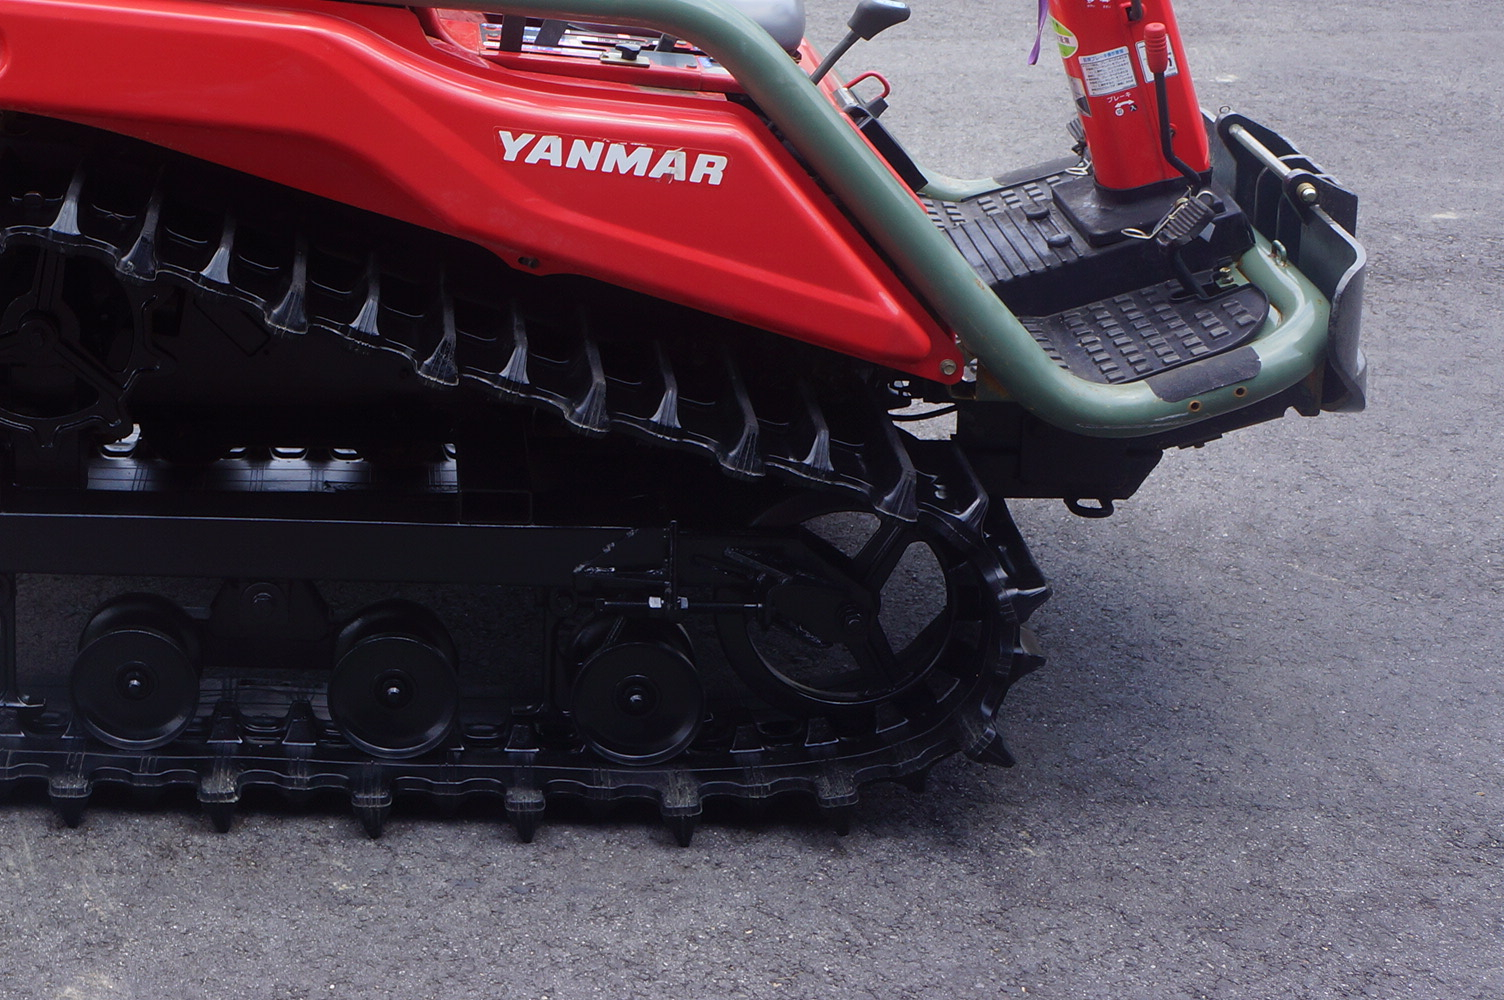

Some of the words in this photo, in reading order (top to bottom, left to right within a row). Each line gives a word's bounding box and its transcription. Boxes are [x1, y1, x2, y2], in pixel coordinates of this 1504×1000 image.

[1107, 92, 1131, 103] ブレーキ
[498, 130, 728, 185] YANMAR
